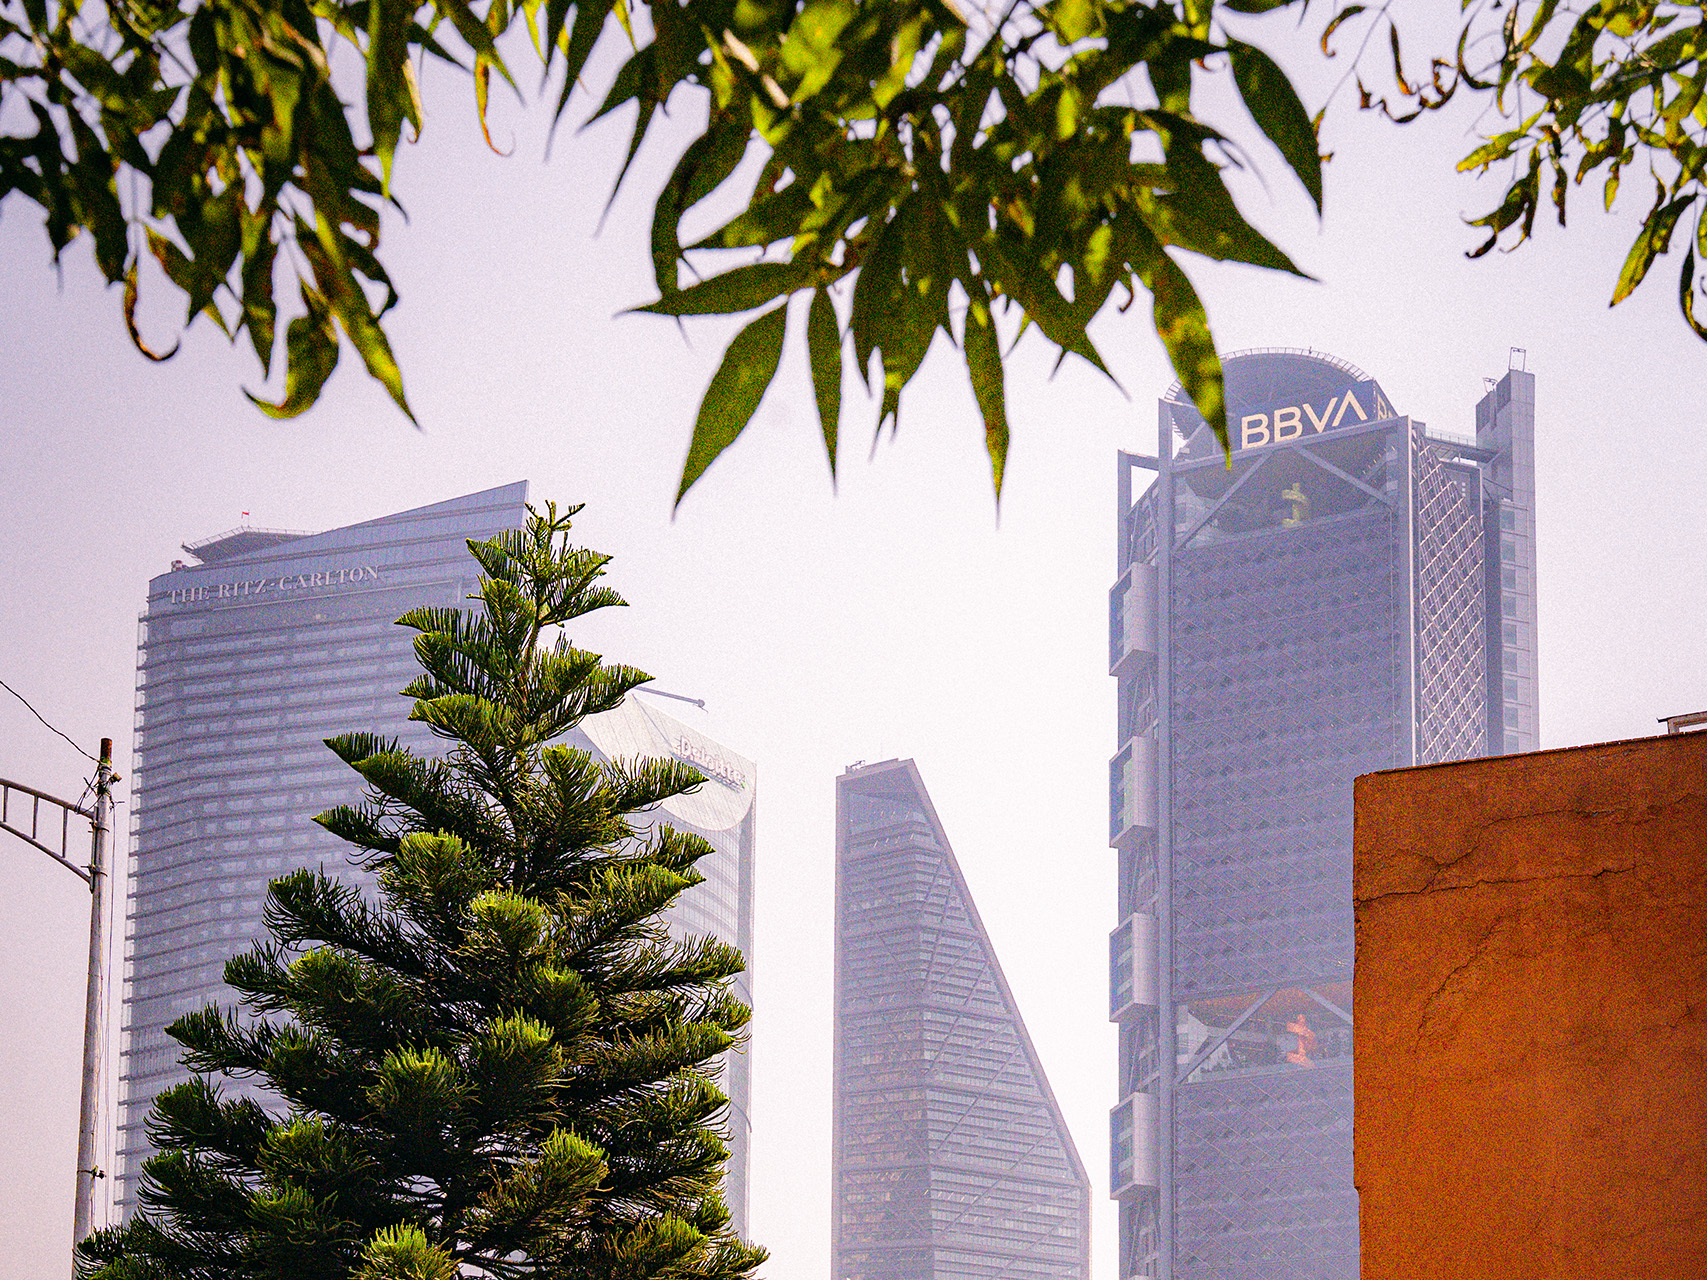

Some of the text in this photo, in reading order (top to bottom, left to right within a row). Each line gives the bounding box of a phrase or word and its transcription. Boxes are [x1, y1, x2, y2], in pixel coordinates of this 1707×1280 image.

[1241, 389, 1369, 450] BBVA
[167, 565, 380, 604] THE RITZ-CARLTON
